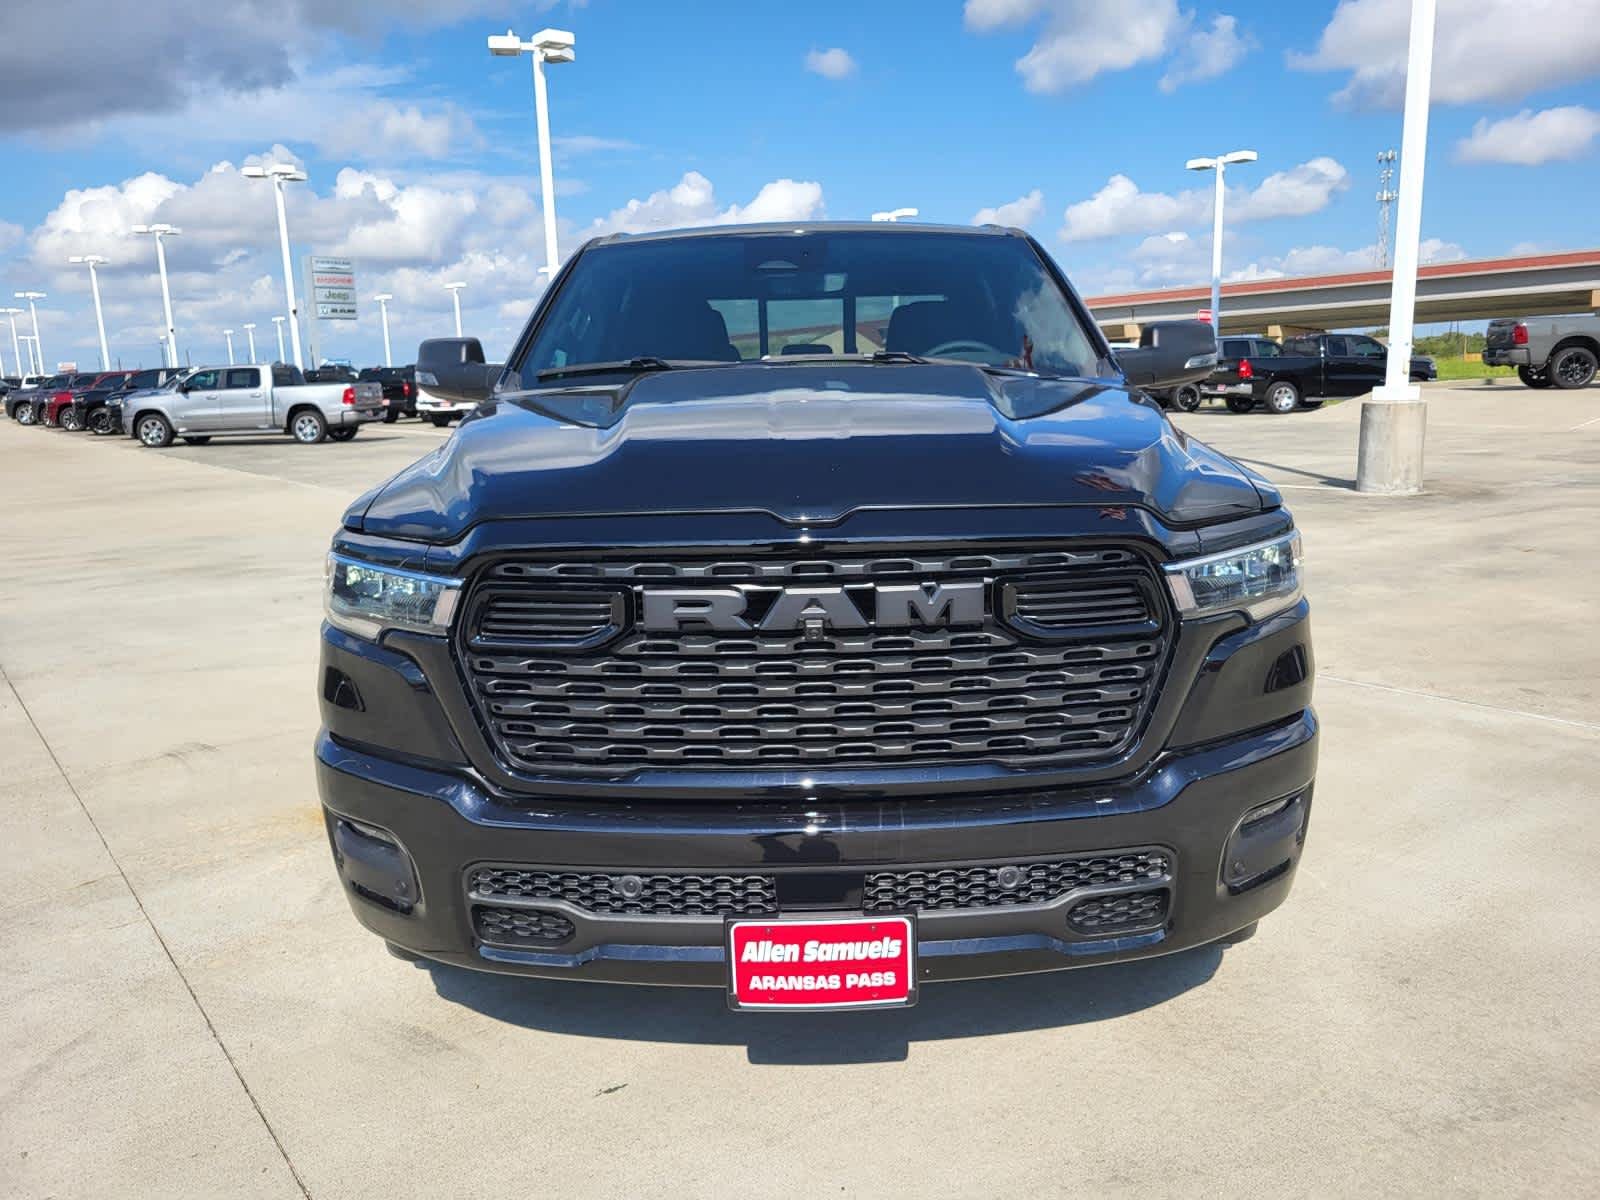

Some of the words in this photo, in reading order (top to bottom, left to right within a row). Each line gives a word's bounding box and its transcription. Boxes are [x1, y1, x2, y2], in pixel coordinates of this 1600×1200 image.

[324, 290, 349, 301] Jeep
[642, 582, 985, 631] RAM
[741, 940, 800, 963] Allen
[803, 937, 902, 963] Samuels
[749, 974, 841, 990] ARANSAS
[845, 971, 896, 989] PASS
